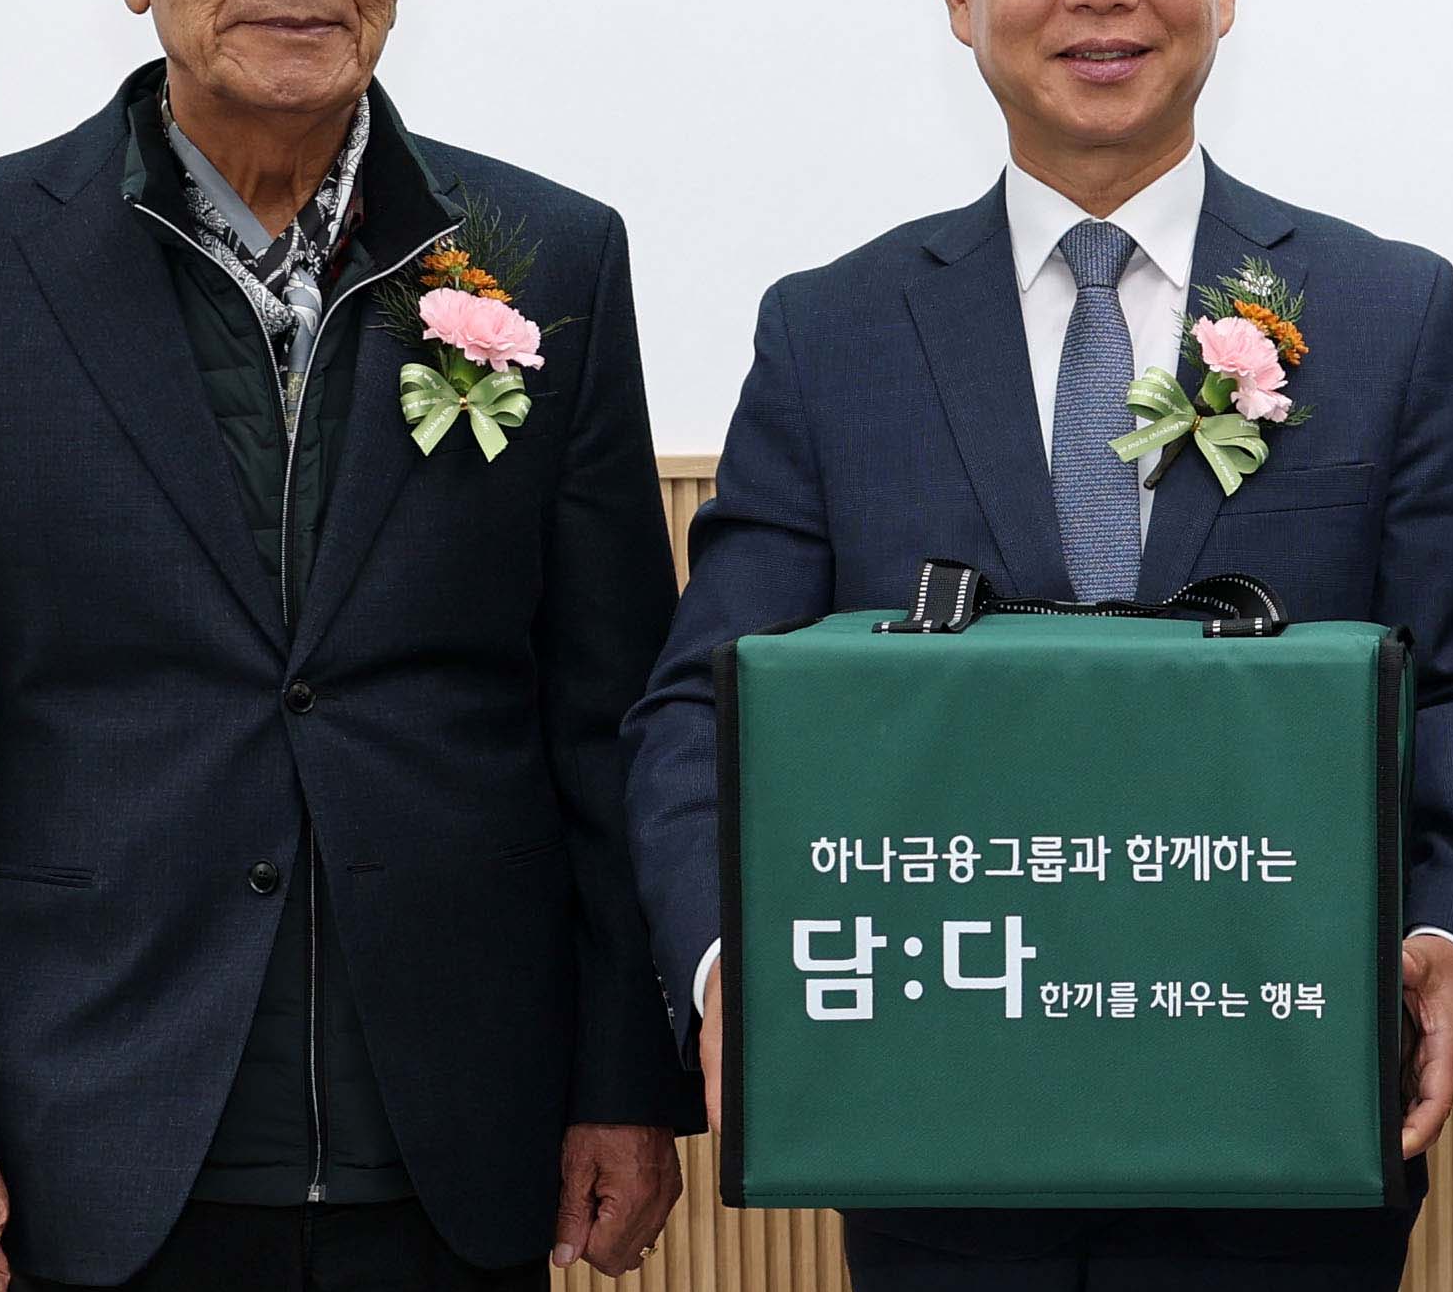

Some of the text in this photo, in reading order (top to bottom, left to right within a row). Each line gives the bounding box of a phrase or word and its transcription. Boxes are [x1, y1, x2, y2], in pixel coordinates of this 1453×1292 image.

[811, 835, 1296, 883] 하나금융그룹과 함께하는
[1040, 982, 1138, 1018] 한끼를
[1150, 982, 1249, 1017] 채우는
[1260, 982, 1325, 1019] 행복
